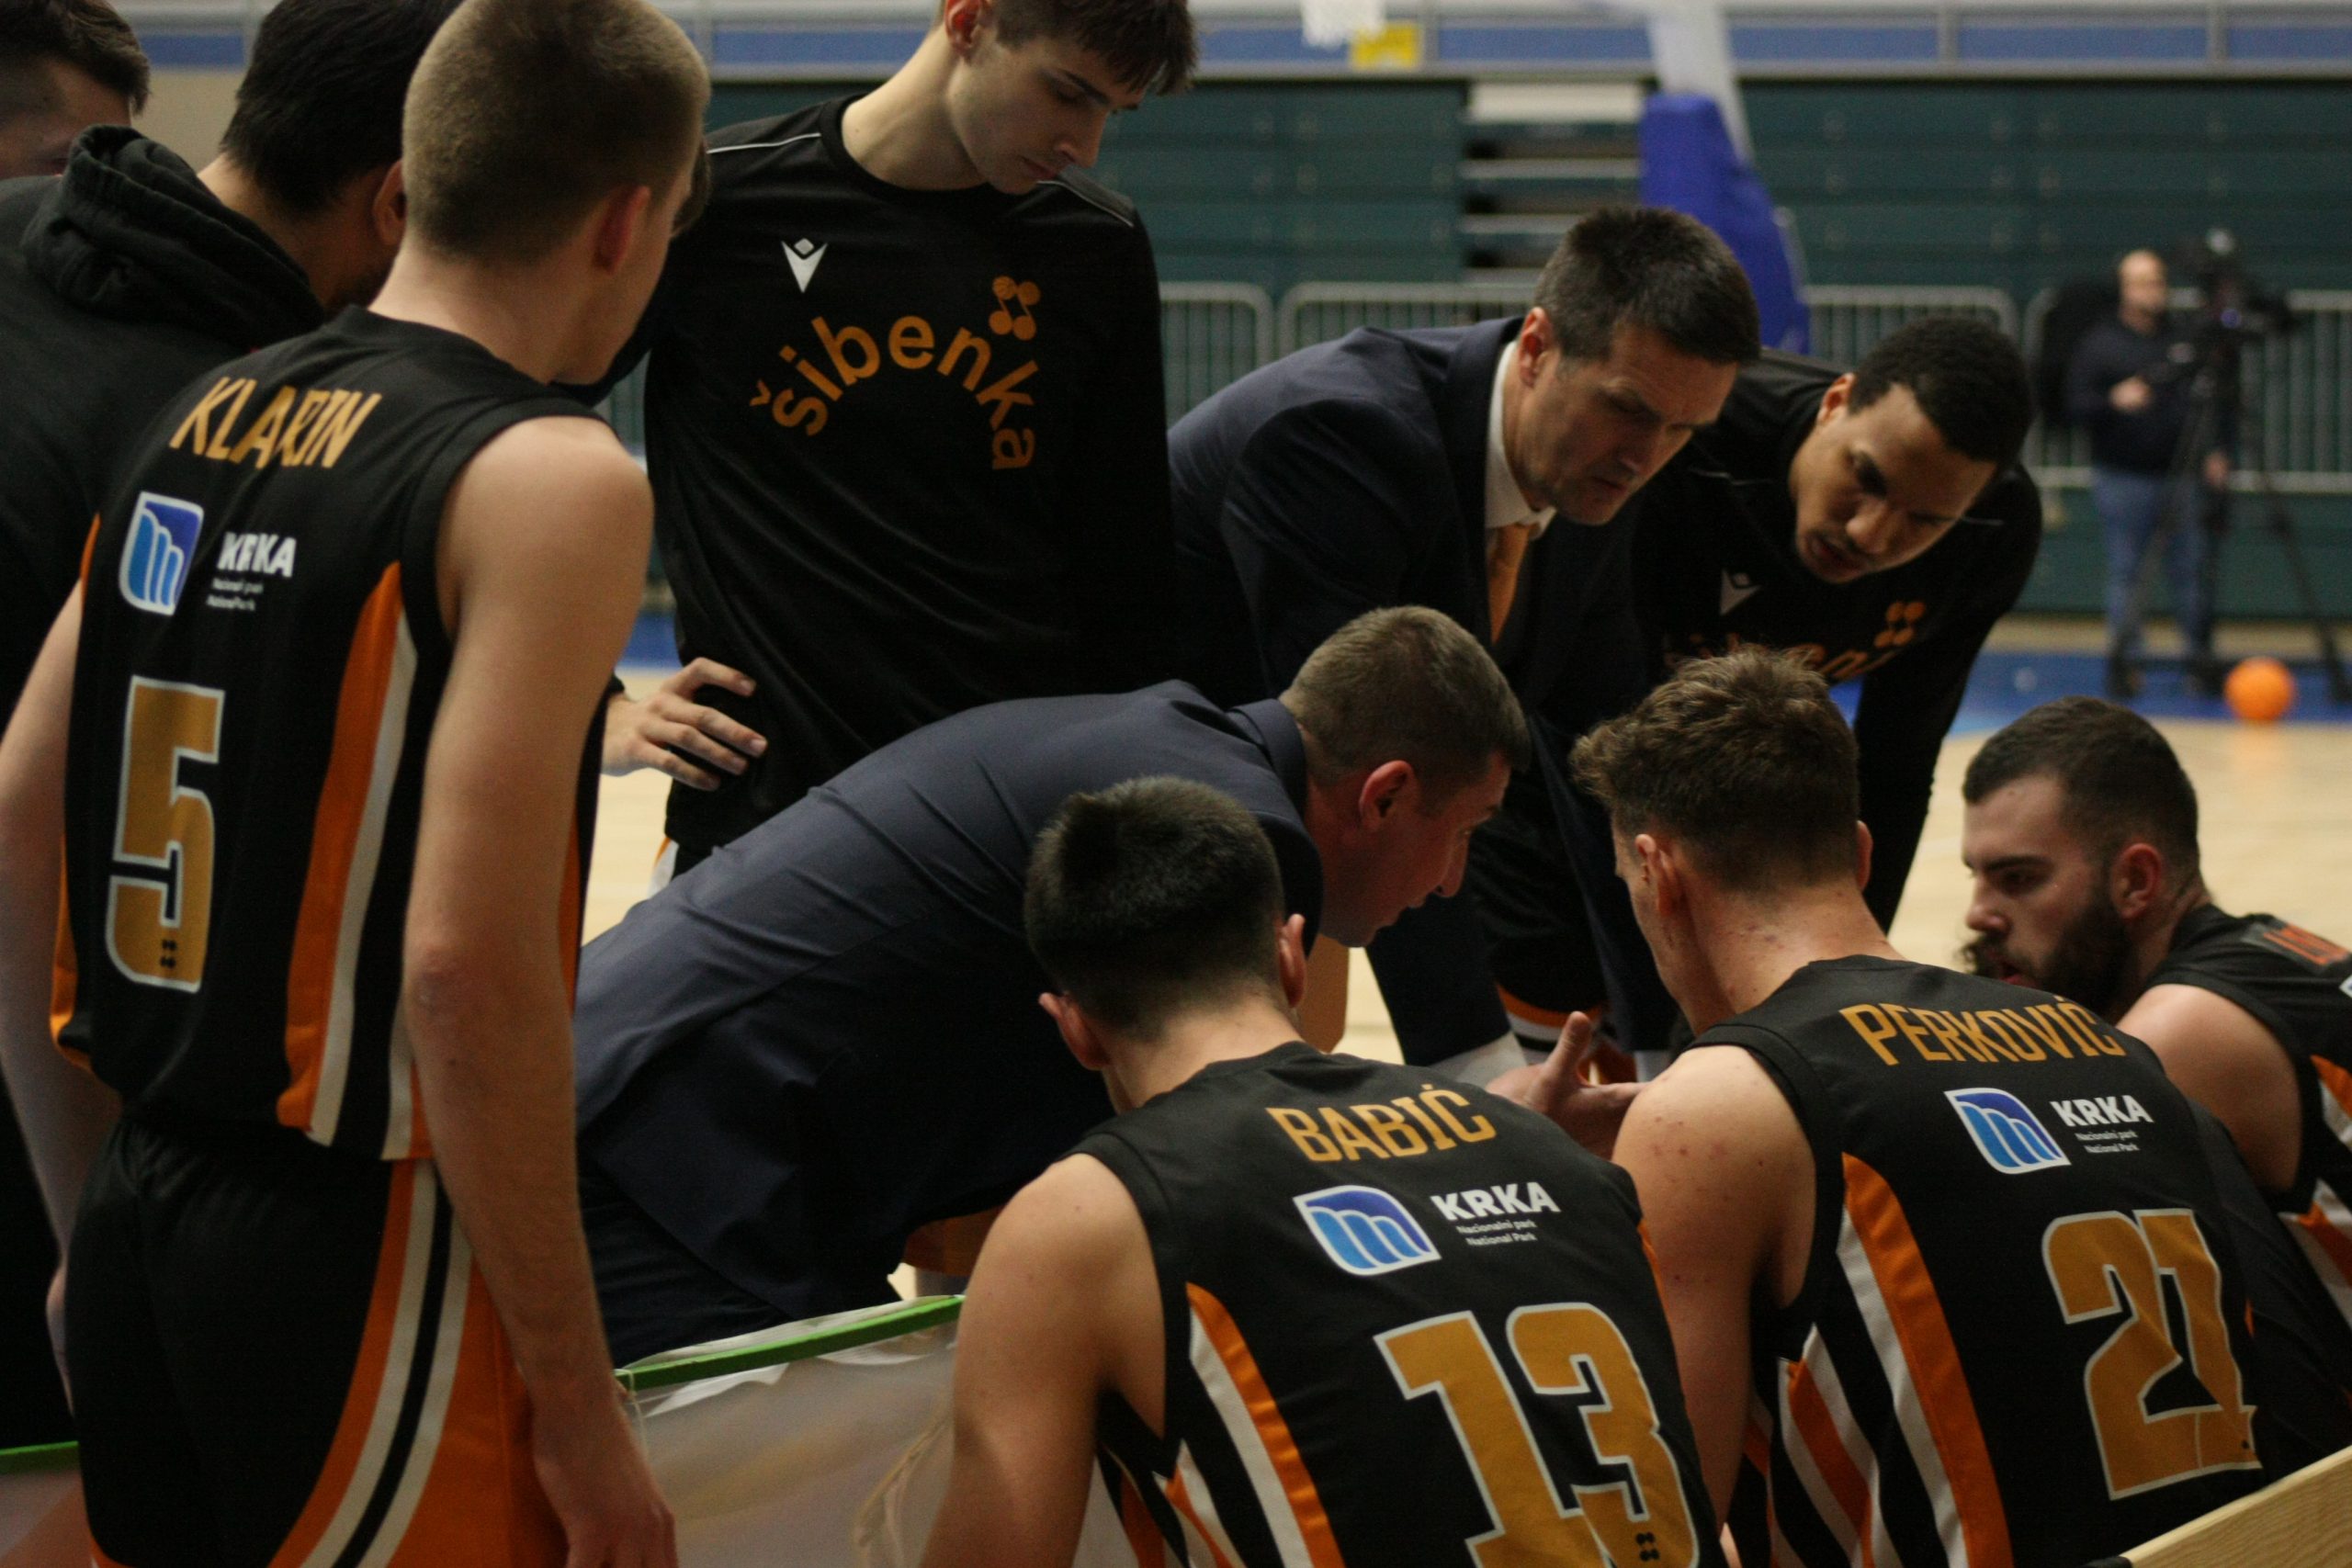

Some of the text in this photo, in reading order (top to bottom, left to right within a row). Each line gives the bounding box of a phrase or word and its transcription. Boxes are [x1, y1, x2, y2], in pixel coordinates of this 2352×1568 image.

[169, 377, 382, 469] KLARIN
[106, 675, 225, 993] 5
[1838, 995, 2127, 1066] PERKOVIĆ
[1265, 1084, 1497, 1162] BABIĆ
[2049, 1095, 2154, 1127] KRKA
[1430, 1181, 1562, 1222] KRKA
[1513, 1219, 1538, 1231] park
[1465, 1232, 1538, 1246] National Park
[2041, 1208, 2263, 1501] 21
[1373, 1302, 1700, 1568] 13
